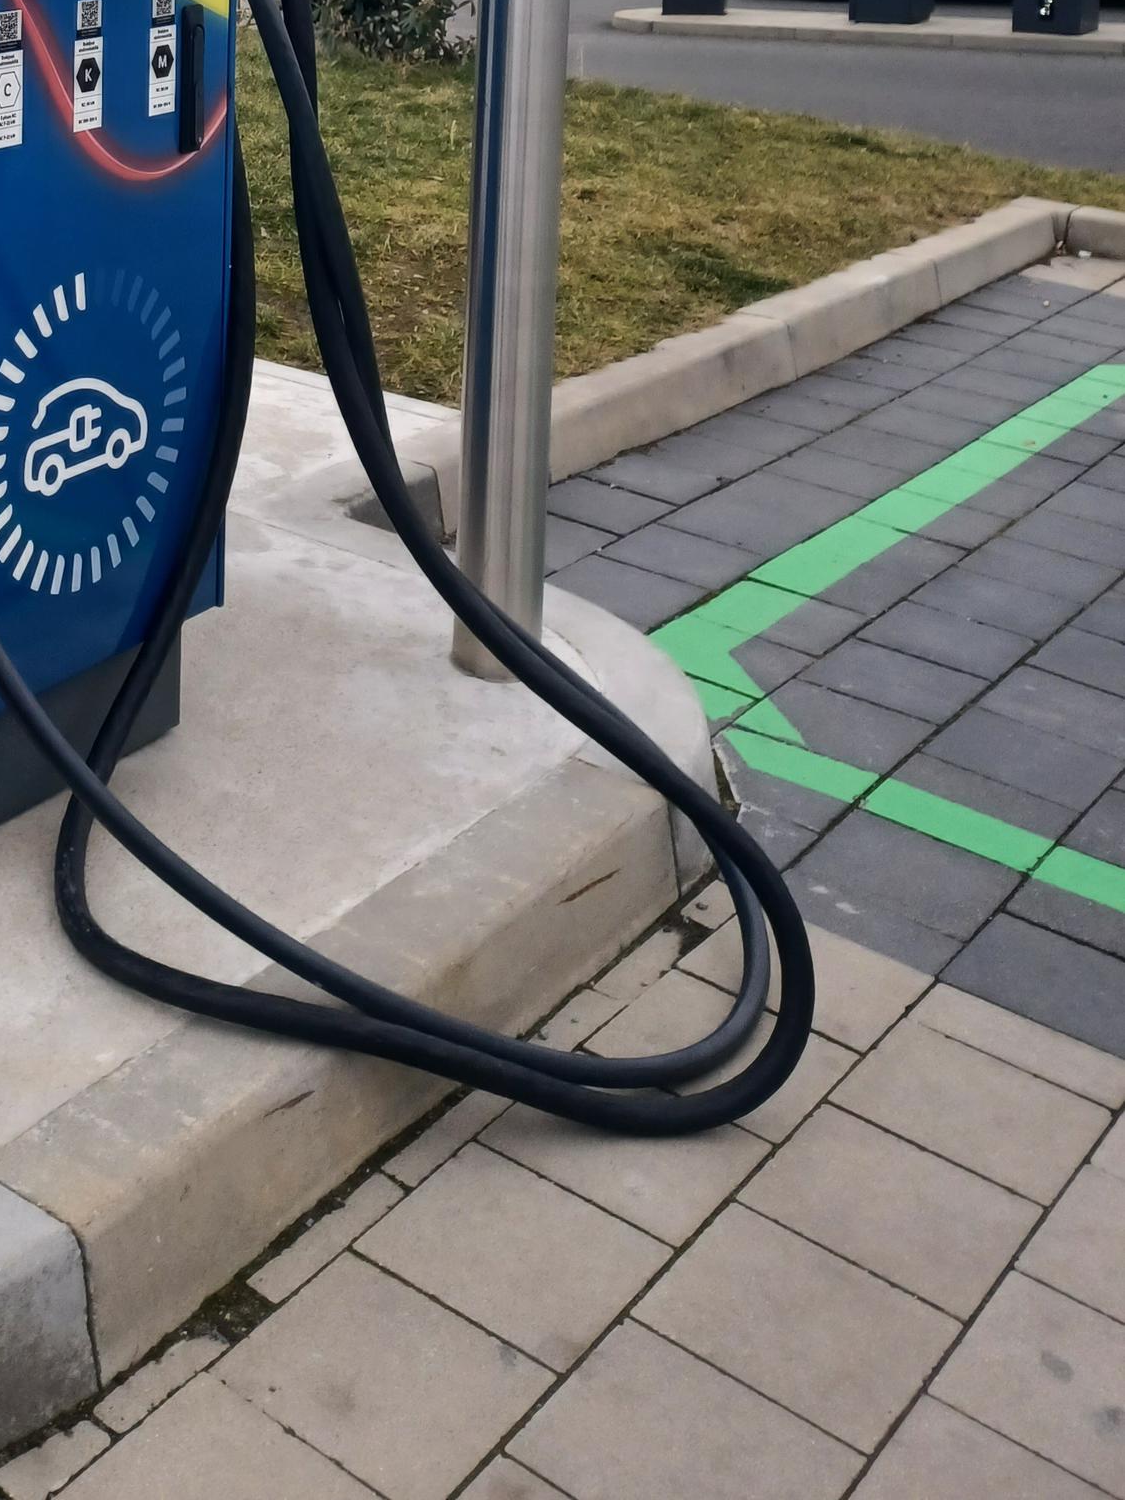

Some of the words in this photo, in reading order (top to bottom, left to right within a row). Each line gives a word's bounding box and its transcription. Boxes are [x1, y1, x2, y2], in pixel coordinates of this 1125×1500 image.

[158, 54, 167, 69] M
[85, 67, 93, 83] K
[4, 83, 12, 97] C
